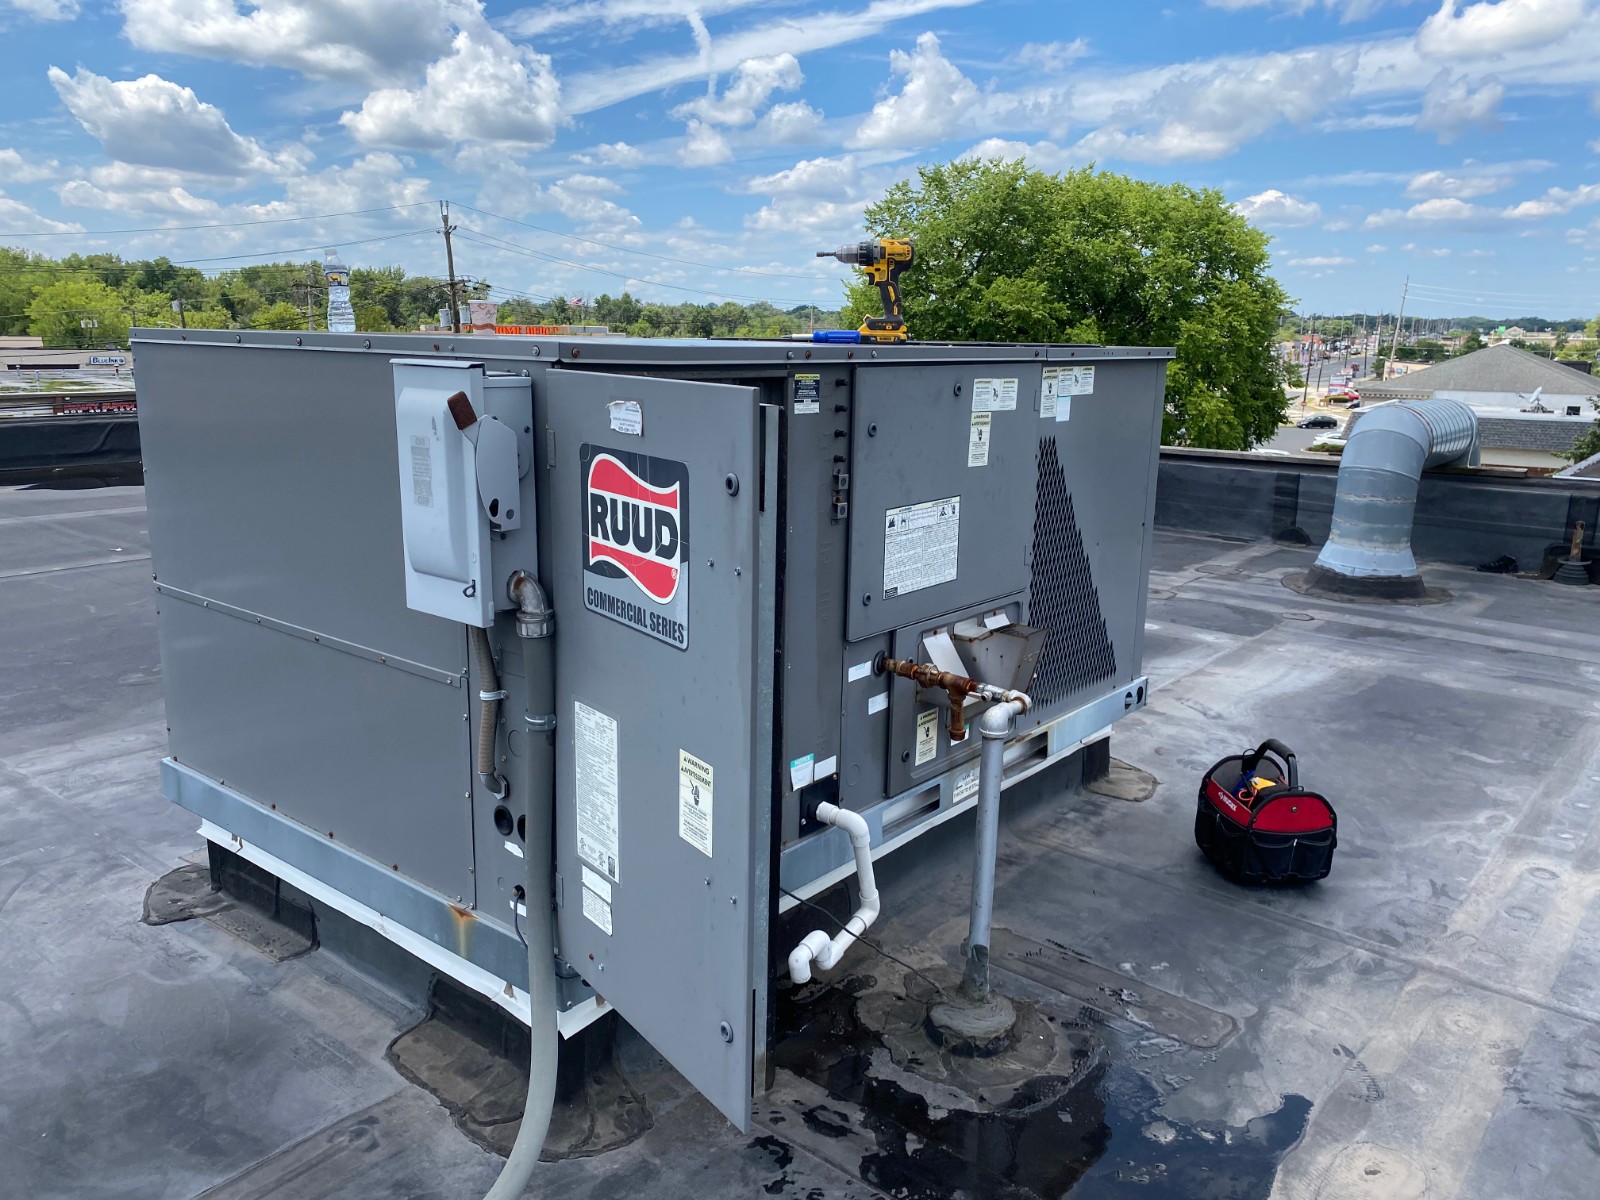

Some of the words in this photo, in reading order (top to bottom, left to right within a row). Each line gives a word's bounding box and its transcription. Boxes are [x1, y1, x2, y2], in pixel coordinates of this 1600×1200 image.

[590, 492, 679, 560] RUUD
[587, 587, 648, 629] COMMERCIAL
[649, 611, 685, 645] SERIES
[687, 759, 710, 776] WARNING
